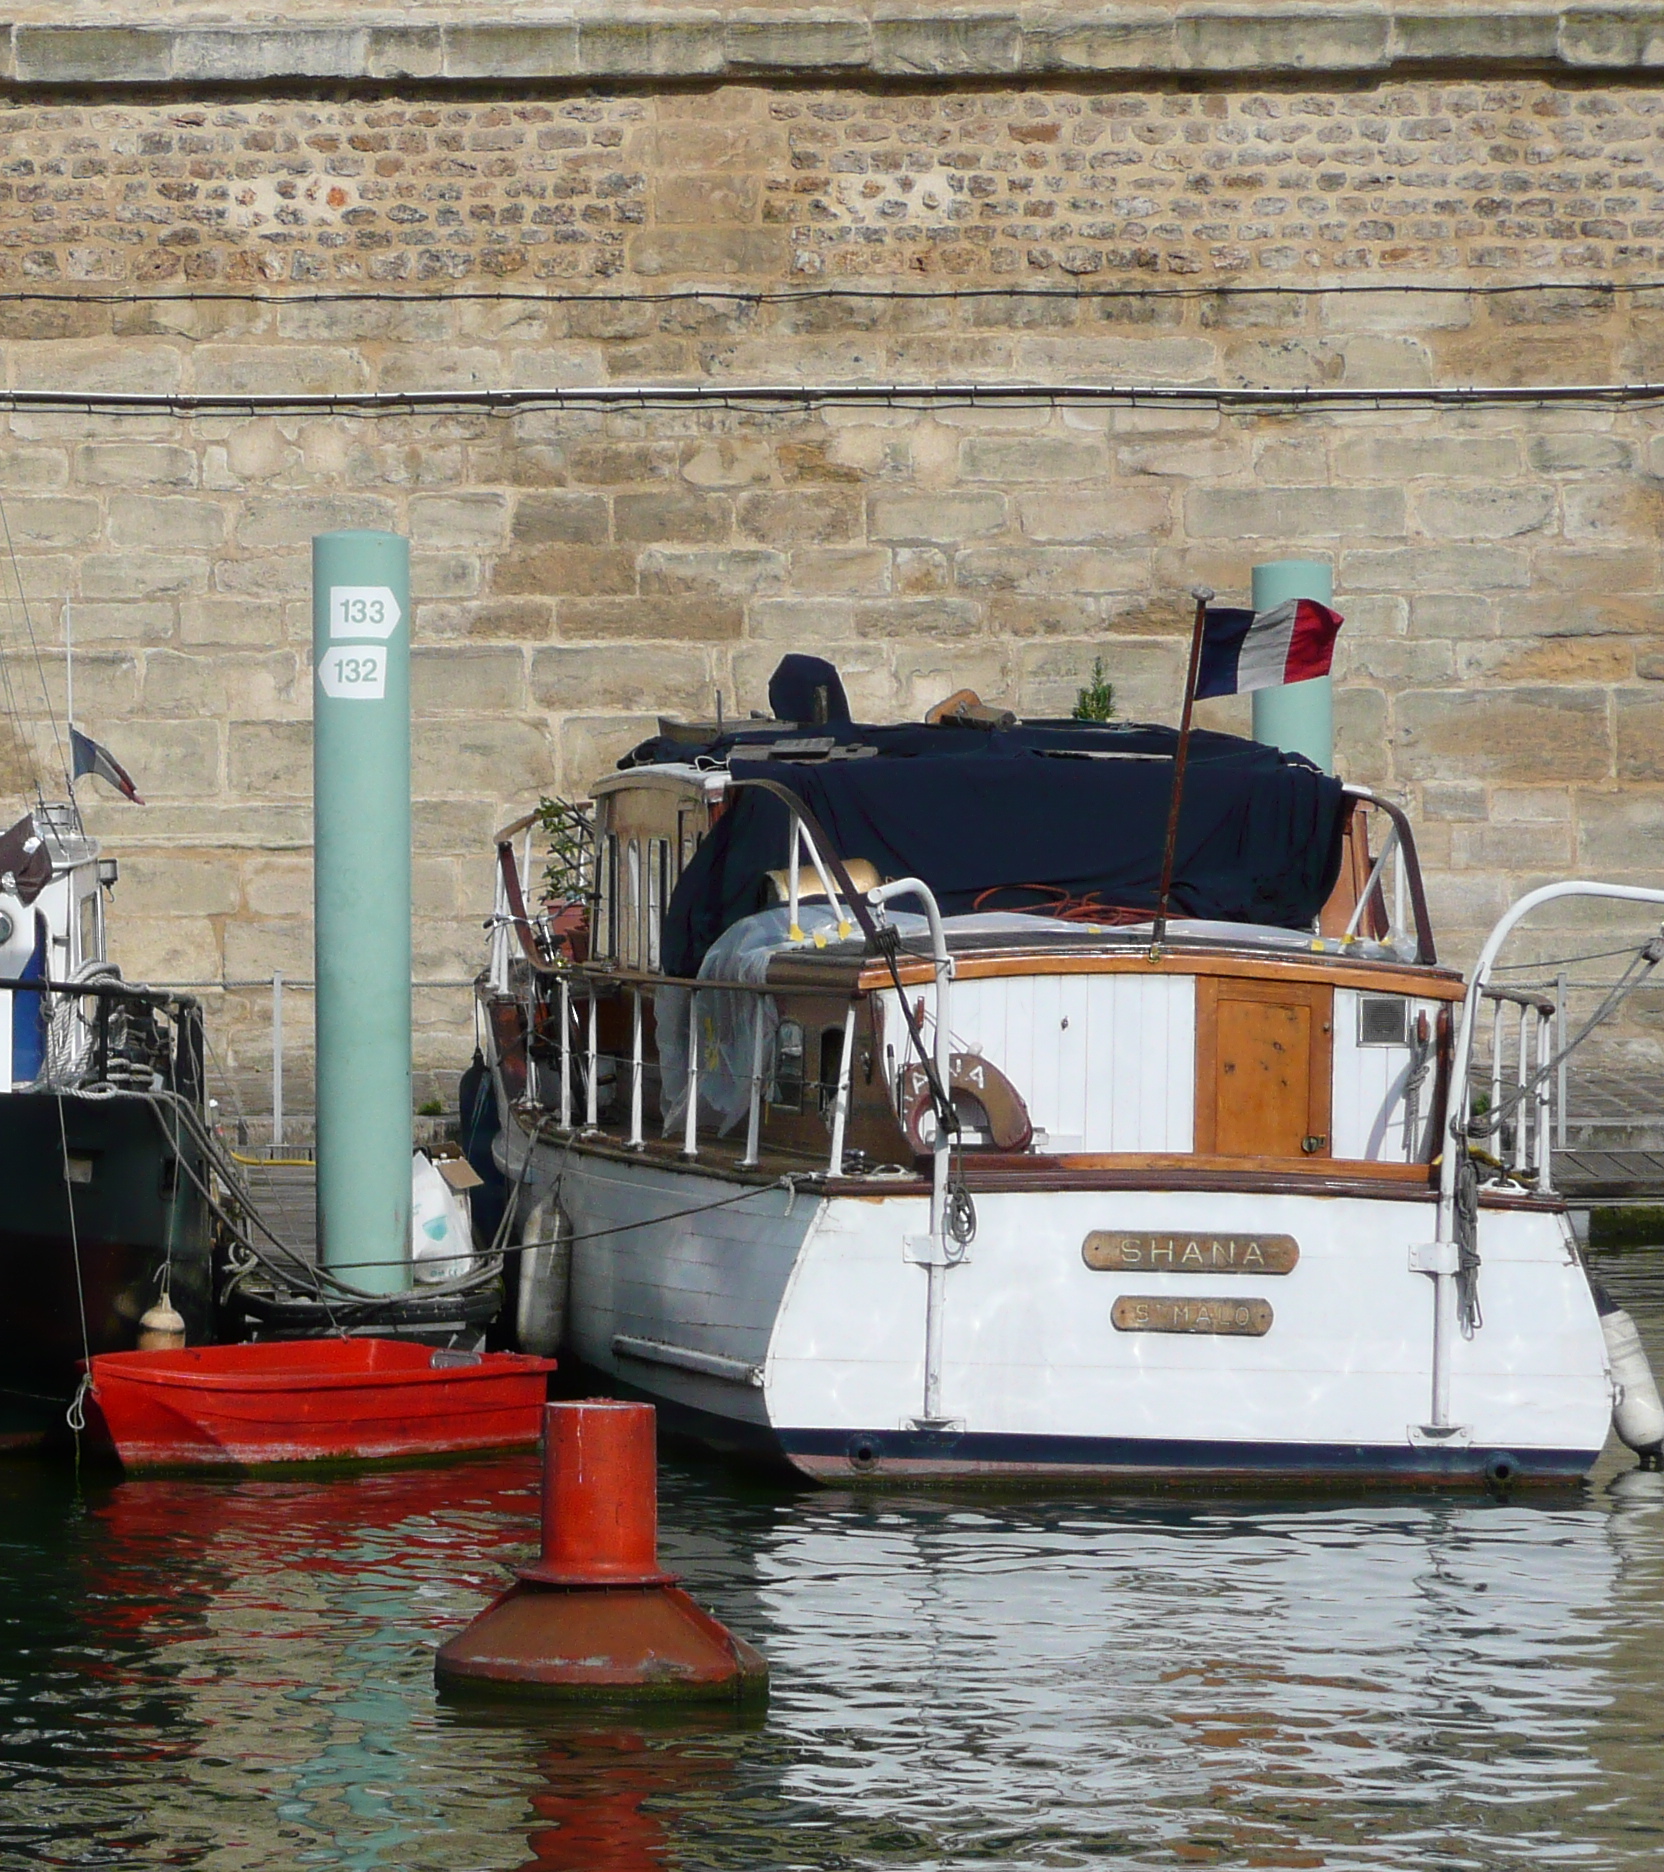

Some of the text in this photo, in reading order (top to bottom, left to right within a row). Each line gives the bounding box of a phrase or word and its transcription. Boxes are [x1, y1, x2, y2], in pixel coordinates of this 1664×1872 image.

[340, 598, 385, 624] 133
[334, 657, 378, 683] 132
[1120, 1239, 1265, 1266] SHANA
[1173, 1304, 1250, 1326] MALO
